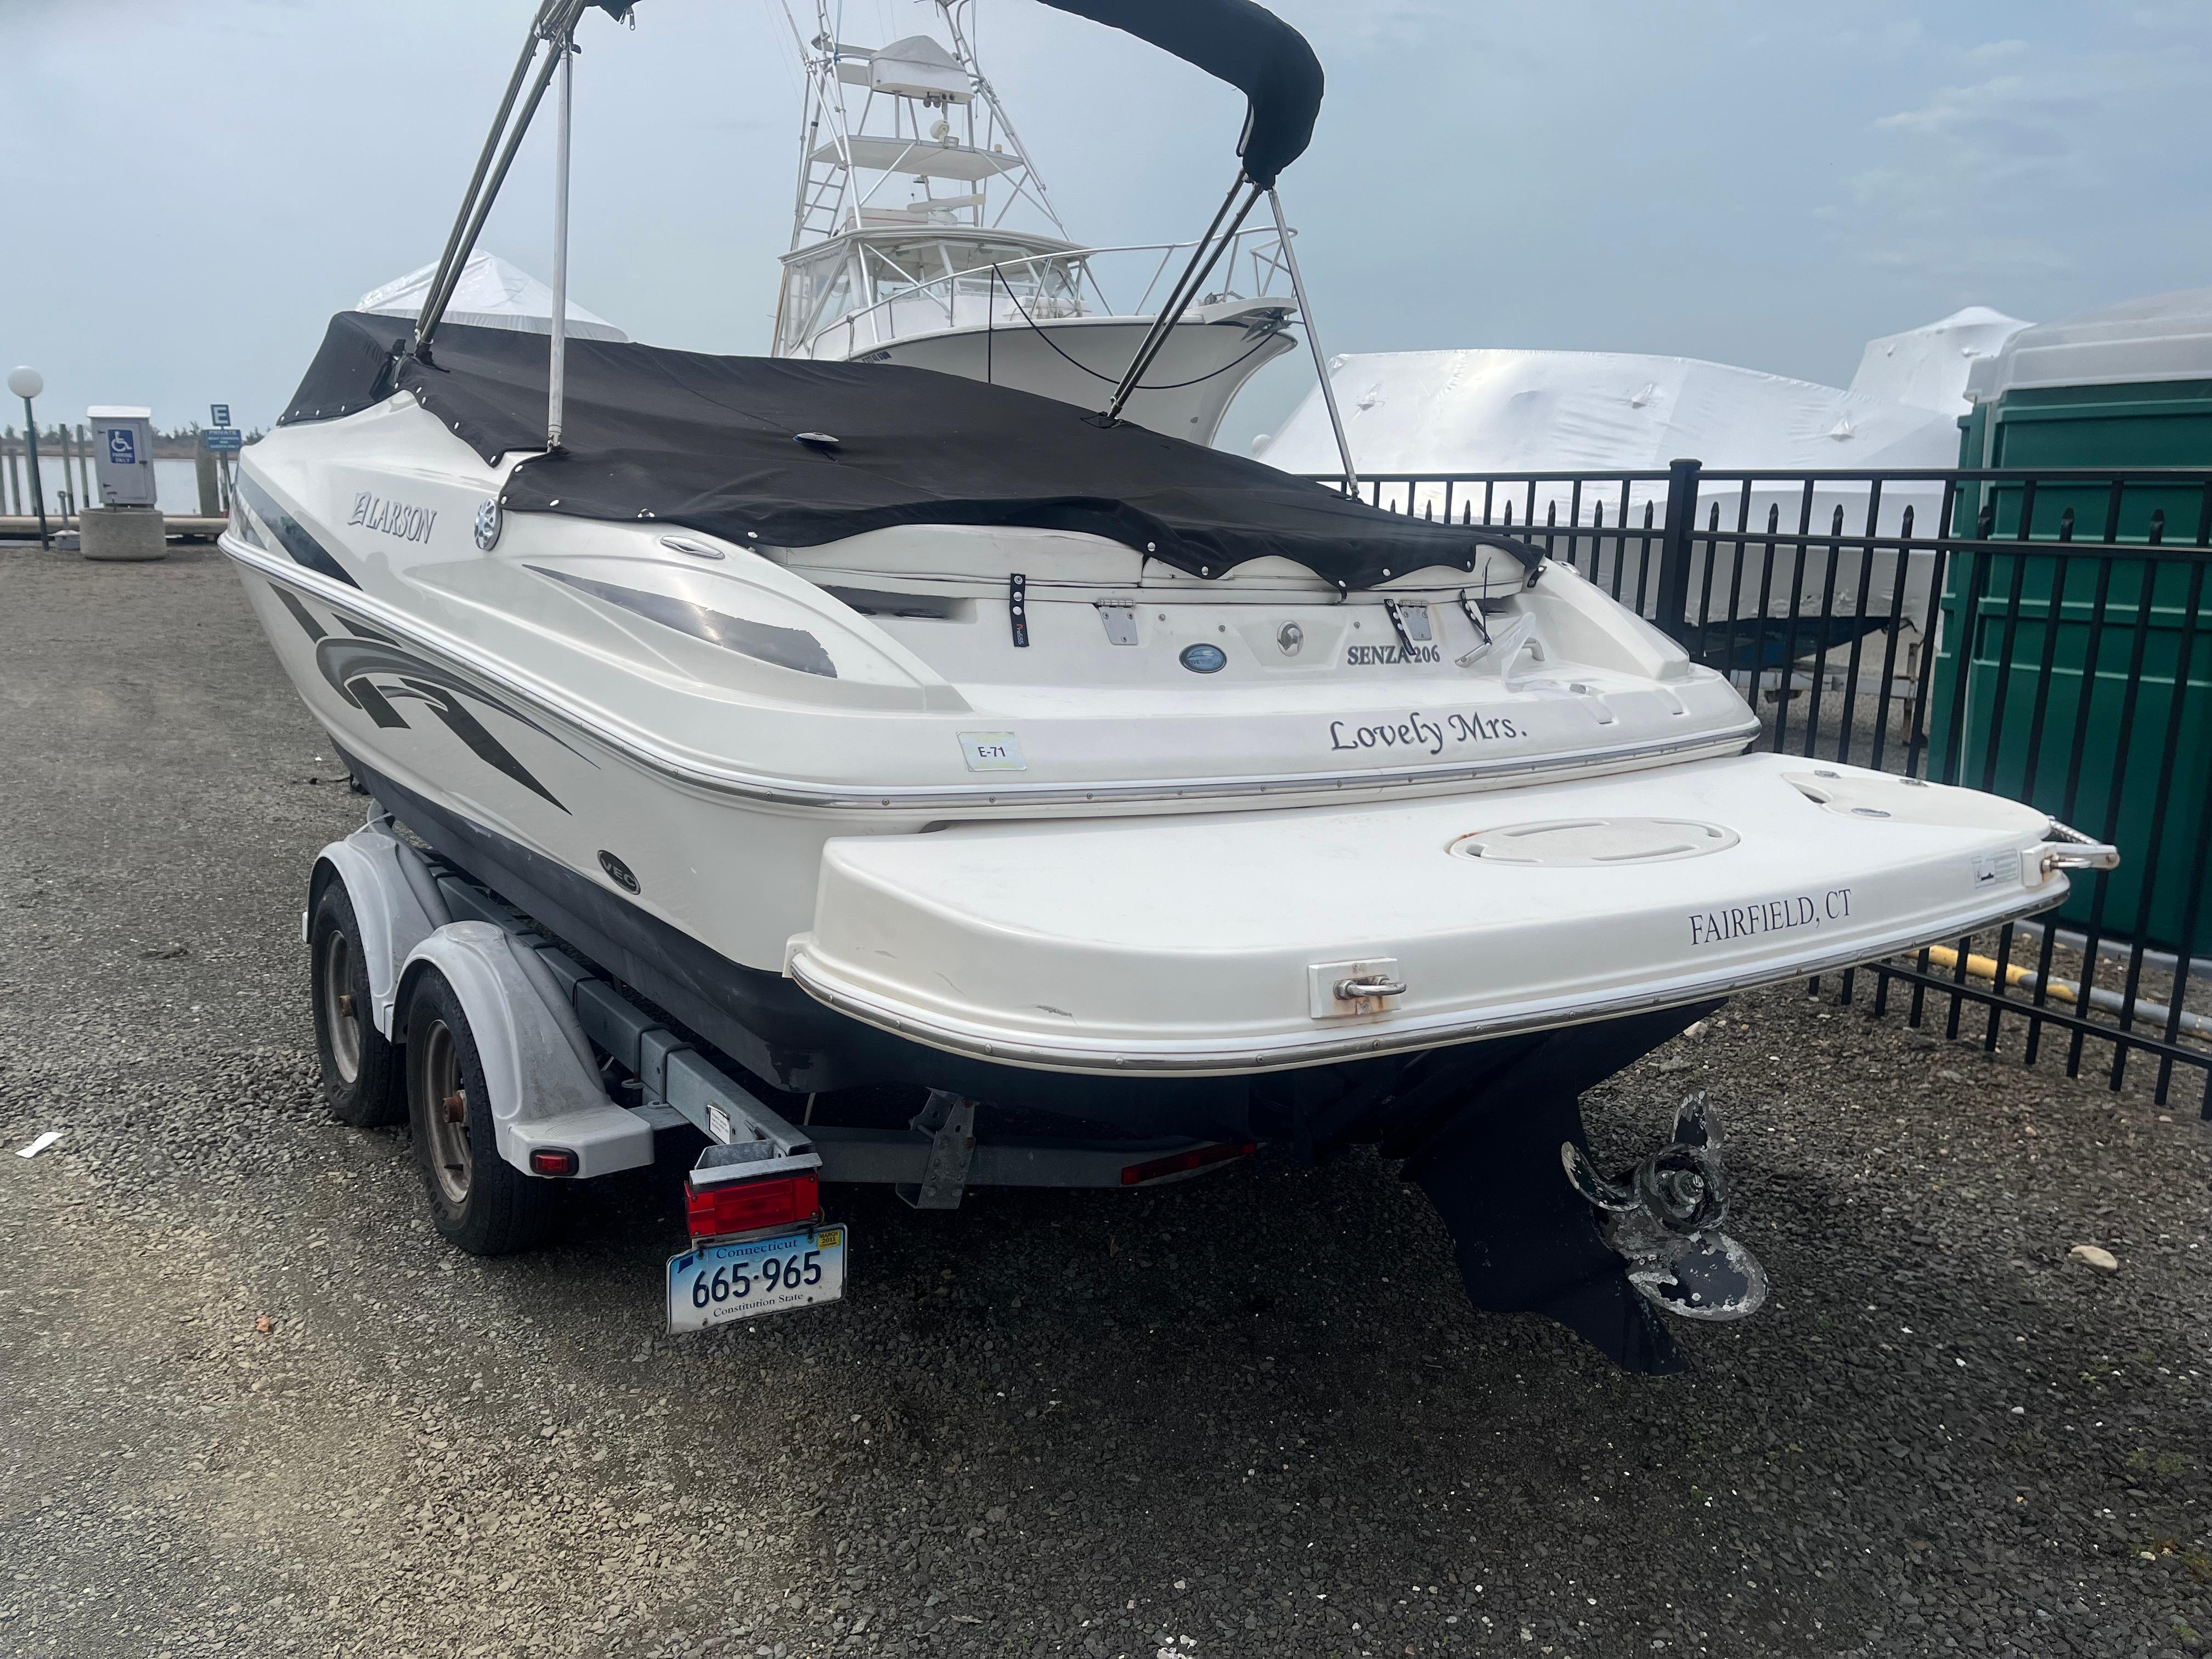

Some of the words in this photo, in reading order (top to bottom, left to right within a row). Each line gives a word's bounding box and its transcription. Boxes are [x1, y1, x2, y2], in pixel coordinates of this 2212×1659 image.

[213, 407, 228, 424] E
[365, 496, 438, 545] LARSON
[1347, 645, 1412, 666] SENZA
[1414, 644, 1441, 663] 206
[1330, 712, 1443, 755] Lovely
[1448, 710, 1527, 742] Mrs.
[977, 746, 1006, 757] E-71
[601, 857, 636, 887] VEC
[1689, 896, 1820, 946] FAIRFIELD,
[1826, 888, 1852, 919] CT
[819, 1231, 838, 1239] MARCH
[716, 1239, 798, 1260] Connecticut
[713, 1297, 776, 1318] Constitution
[778, 1293, 804, 1304] State
